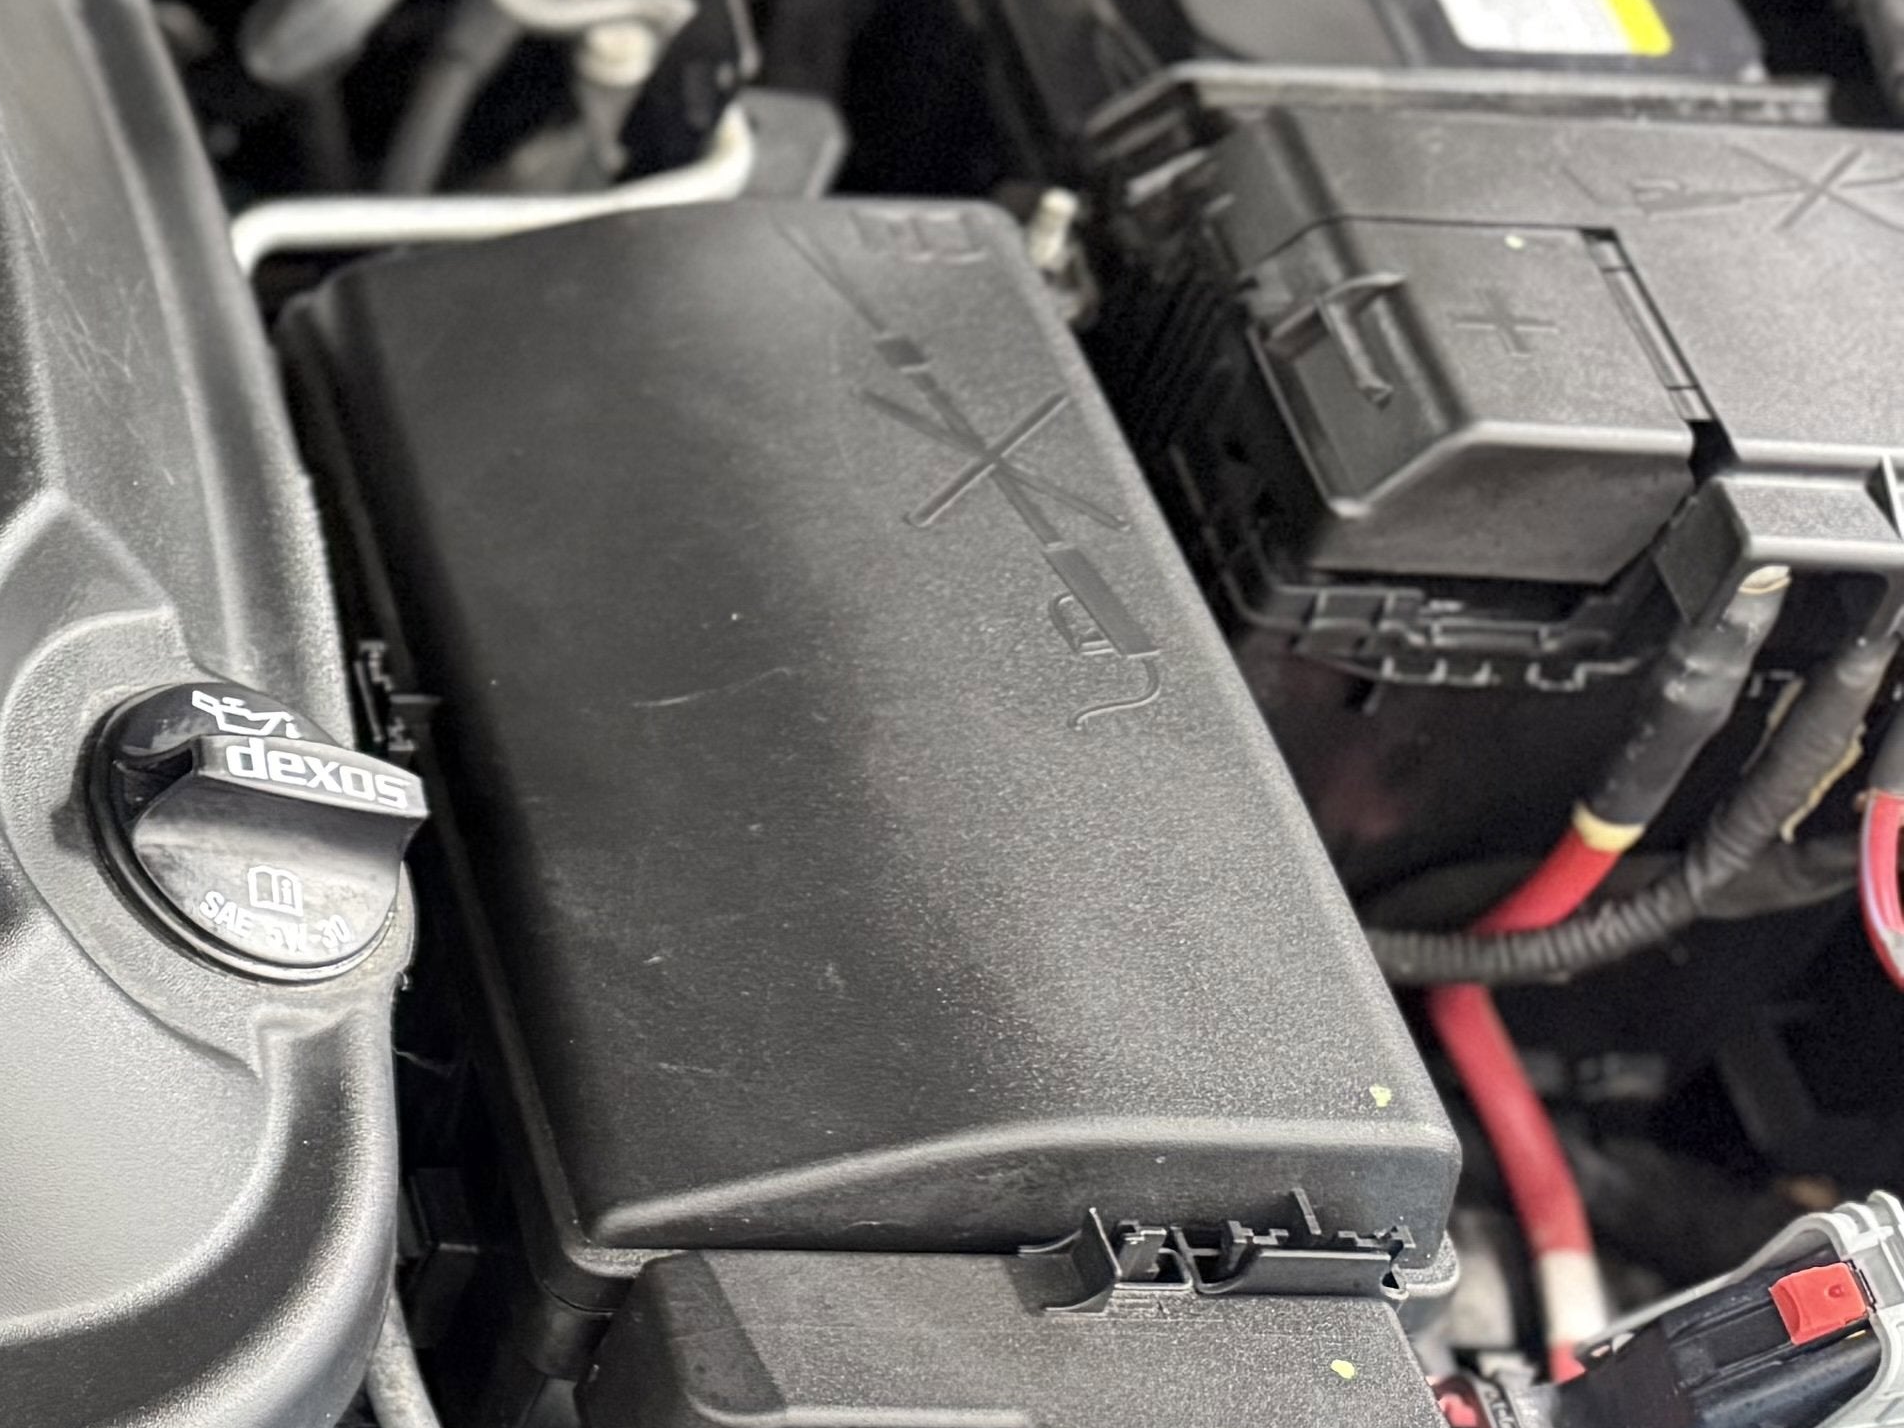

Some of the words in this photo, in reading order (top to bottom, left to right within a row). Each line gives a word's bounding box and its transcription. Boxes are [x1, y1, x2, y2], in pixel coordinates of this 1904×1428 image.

[225, 738, 416, 810] dexos
[199, 891, 255, 940] SAE
[266, 914, 356, 952] 5W-30
